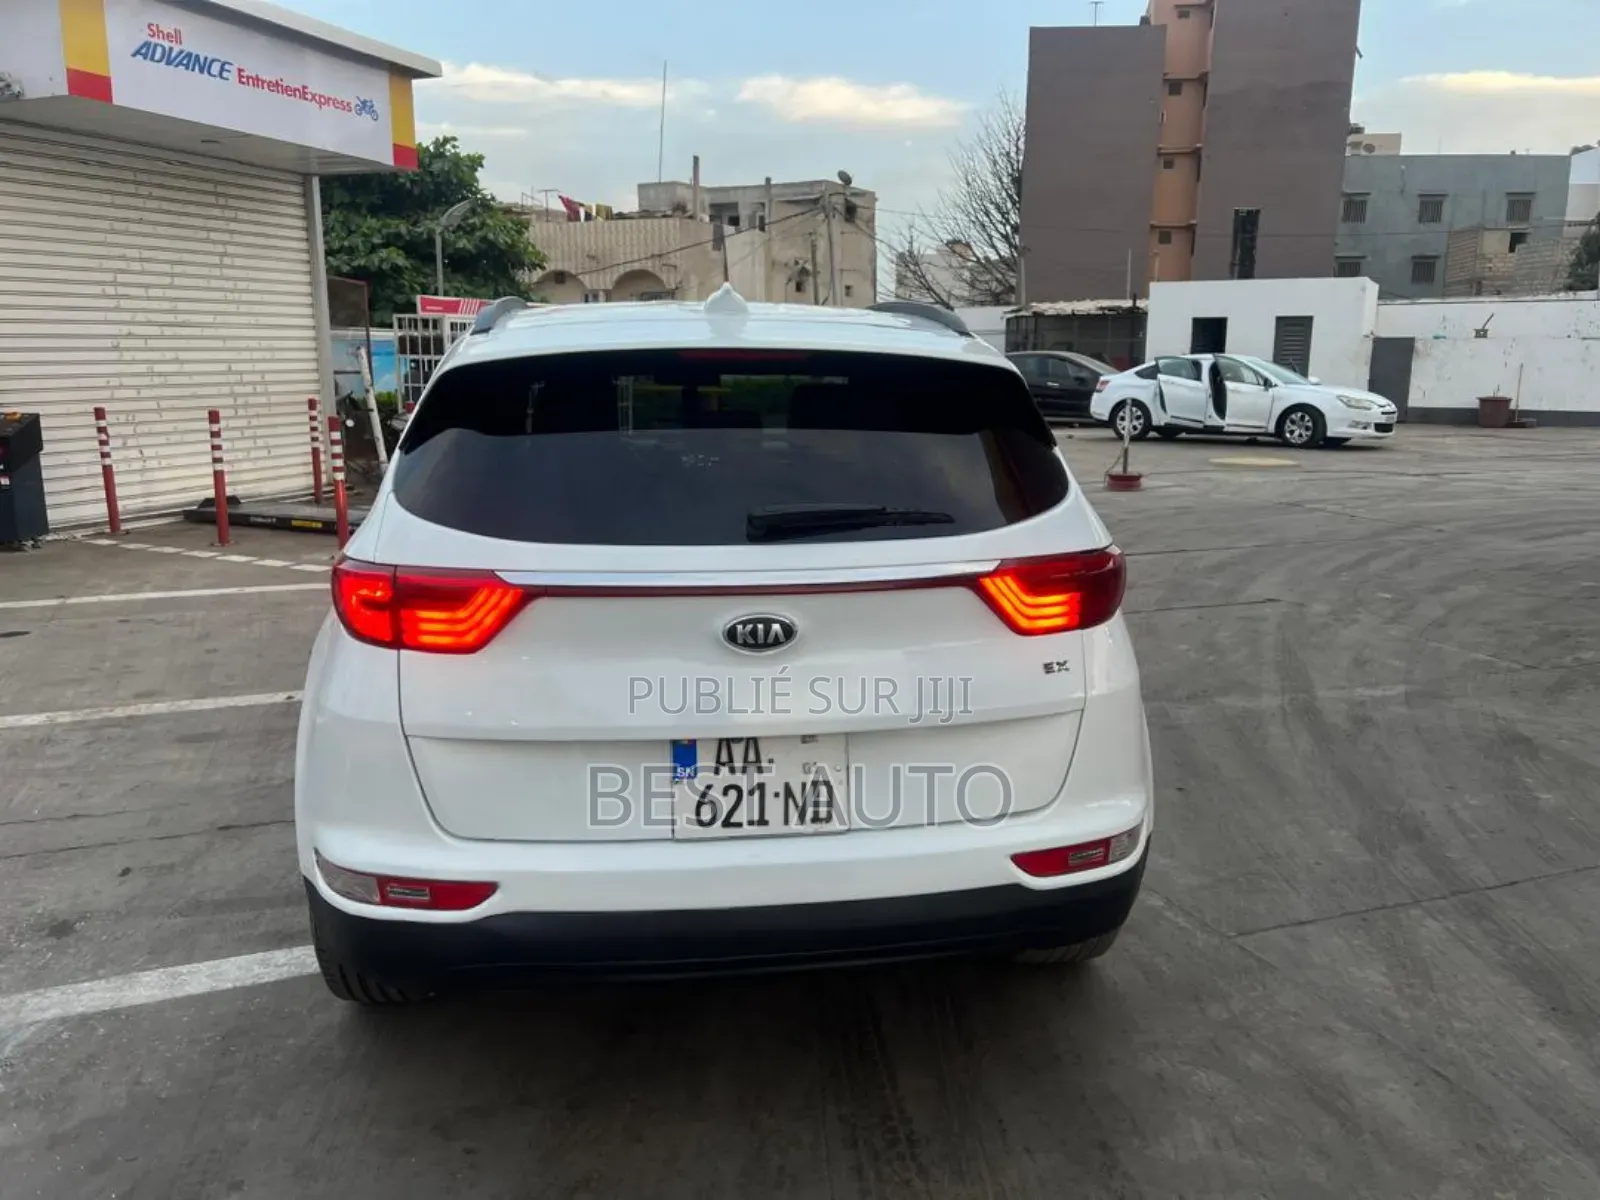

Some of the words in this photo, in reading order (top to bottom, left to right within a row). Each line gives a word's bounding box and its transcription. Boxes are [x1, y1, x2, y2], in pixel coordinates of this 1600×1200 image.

[147, 22, 183, 46] Shell
[131, 40, 234, 81] ADVANCE
[236, 67, 353, 113] EntretienExpress
[735, 623, 786, 644] KIA
[1043, 660, 1070, 675] EX
